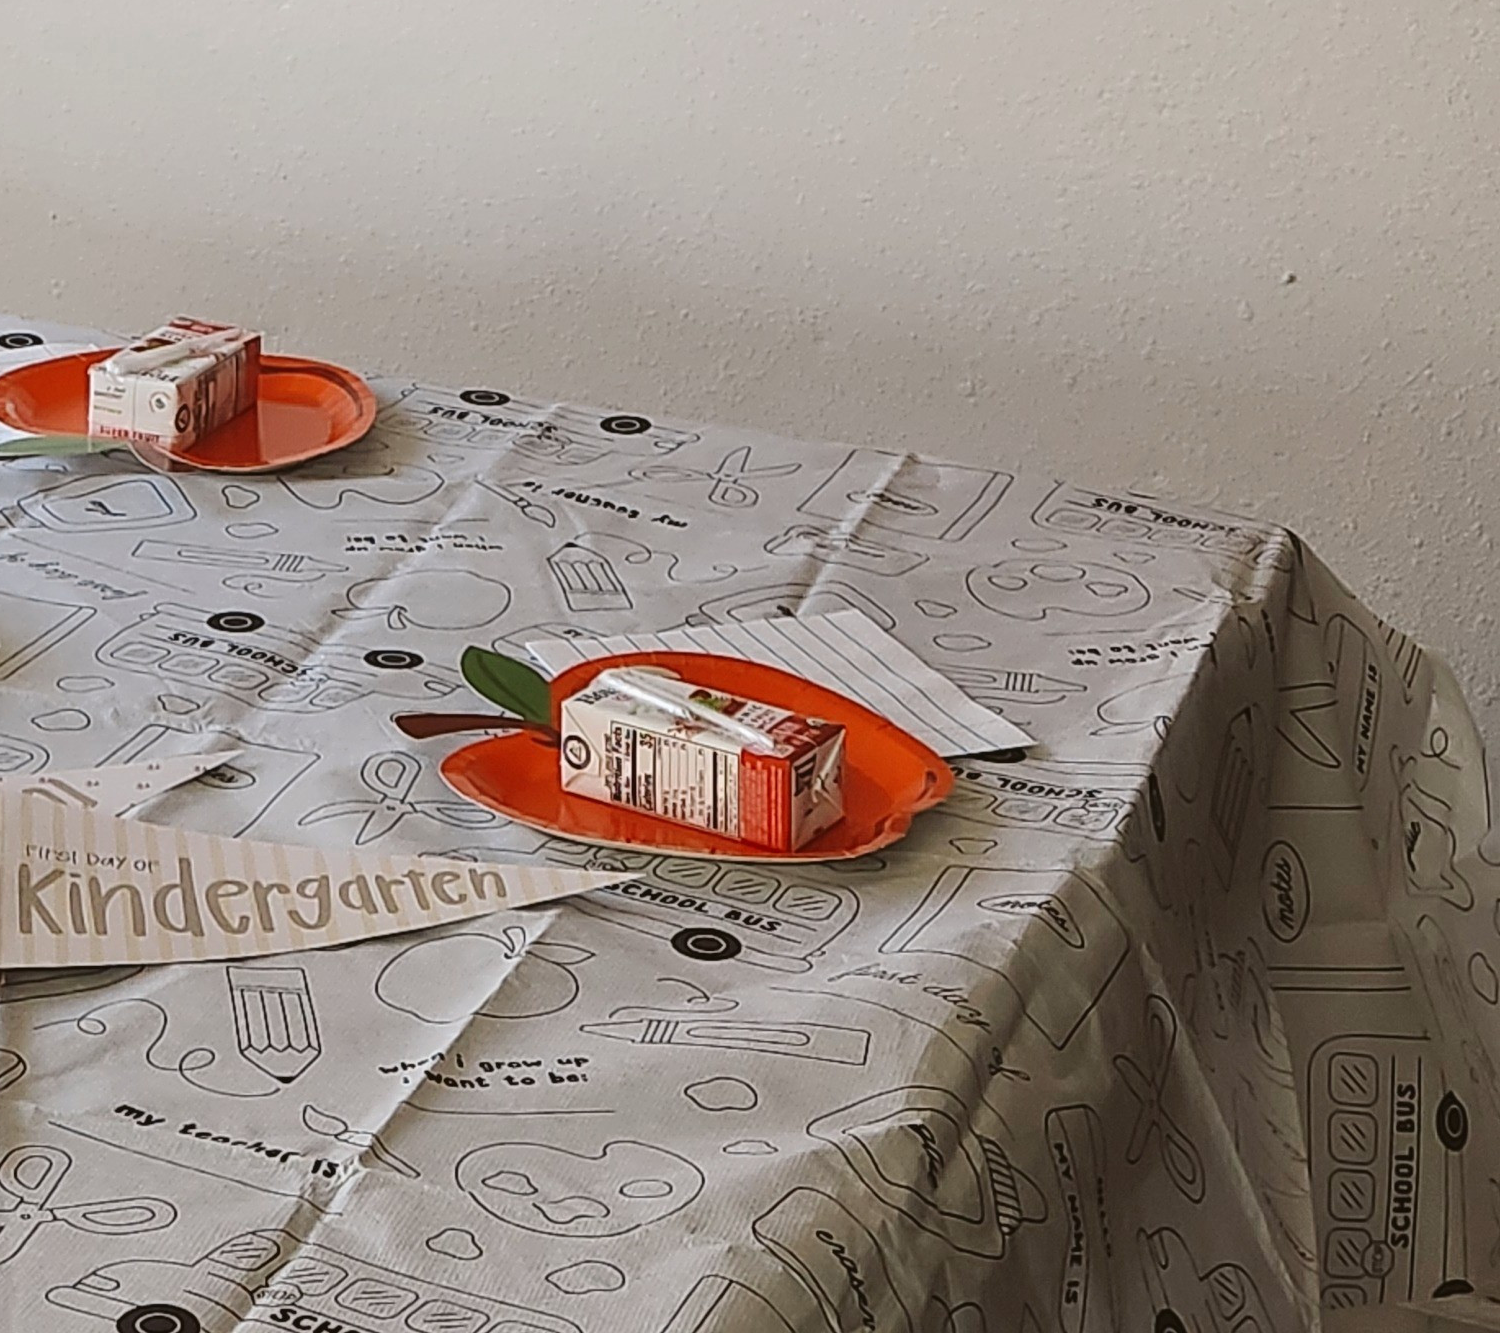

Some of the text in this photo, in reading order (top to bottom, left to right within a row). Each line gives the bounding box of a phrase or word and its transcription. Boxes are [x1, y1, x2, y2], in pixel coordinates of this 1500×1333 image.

[651, 514, 689, 529] my
[1091, 497, 1138, 515] BUS
[168, 631, 314, 677] SCHOOL BUS
[1359, 688, 1375, 740] NAME
[949, 766, 1103, 799] SCHOOL BU
[18, 857, 508, 938] Kindergarten
[1273, 857, 1296, 931] notes
[724, 909, 782, 932] BUS
[423, 1069, 491, 1089] want
[503, 1074, 536, 1086] to
[478, 1058, 543, 1073] grow
[556, 1055, 590, 1068] up
[114, 1104, 167, 1127] my
[178, 1123, 301, 1165] teacher
[1390, 1083, 1416, 1250] SCHOOL BUS
[1053, 1141, 1073, 1181] MY
[1063, 1279, 1080, 1305] IS
